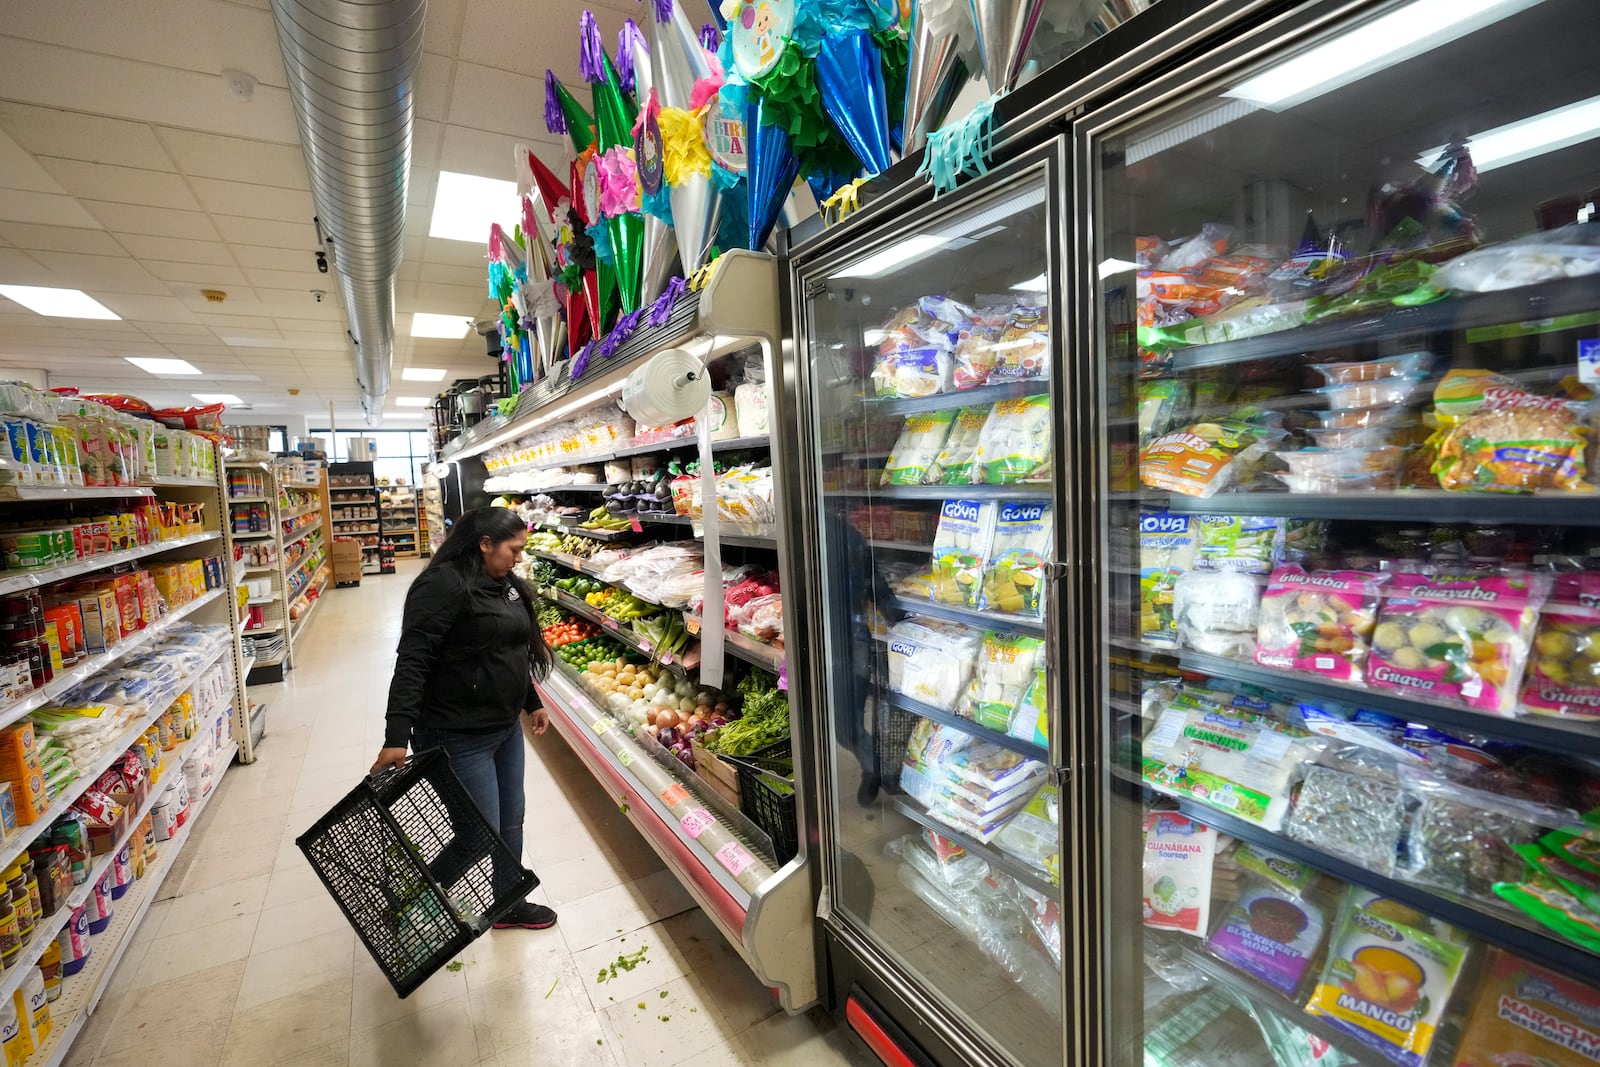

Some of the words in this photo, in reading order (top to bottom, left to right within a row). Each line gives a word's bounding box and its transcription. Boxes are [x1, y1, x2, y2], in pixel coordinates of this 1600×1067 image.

[944, 501, 978, 521] GOYA
[1001, 506, 1041, 520] GOYA
[1279, 572, 1344, 589] Guayaba
[1409, 584, 1499, 602] Guayaba
[893, 642, 914, 656] GOYA
[1373, 666, 1435, 690] Guava
[1158, 850, 1188, 861] Soursop
[1226, 925, 1301, 959] BLACKBERRY
[1240, 938, 1276, 957] MORA
[1337, 993, 1412, 1032] MANGO
[1500, 1007, 1566, 1044] Passion
